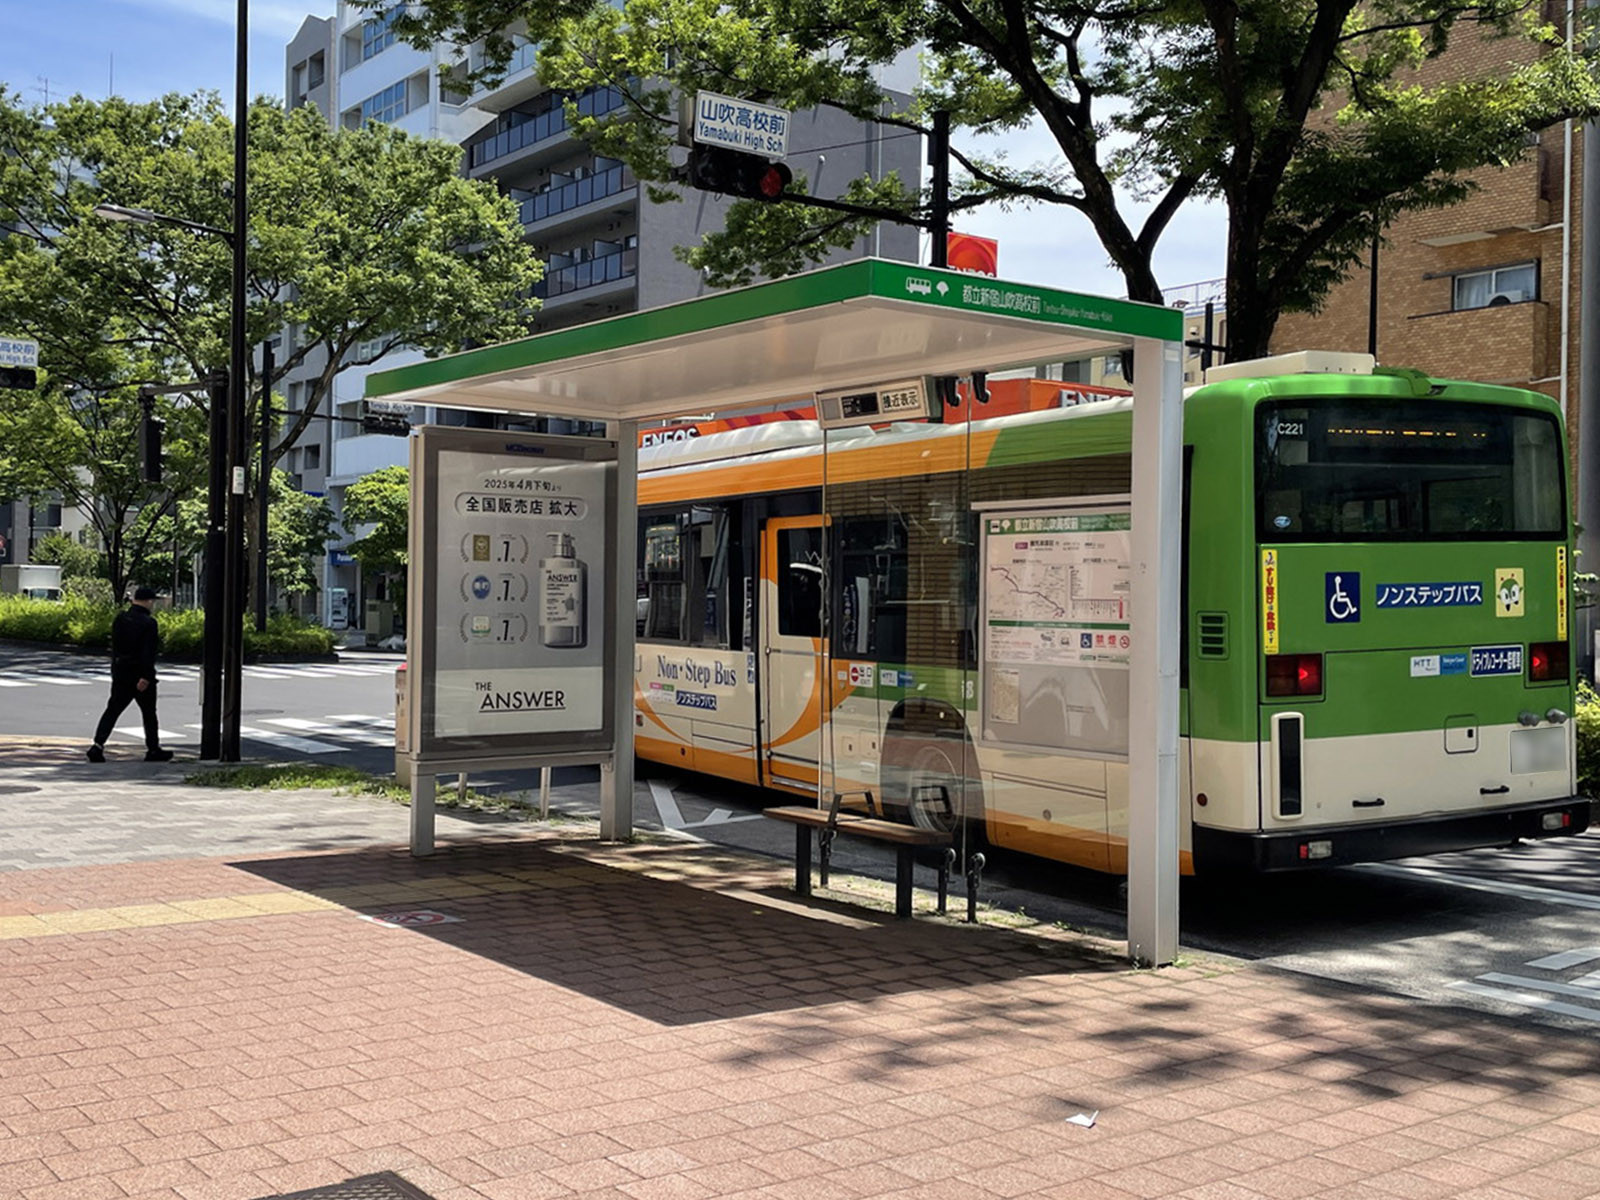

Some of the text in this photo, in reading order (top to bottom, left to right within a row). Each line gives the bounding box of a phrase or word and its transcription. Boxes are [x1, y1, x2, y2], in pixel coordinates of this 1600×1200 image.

[701, 100, 785, 136] 山吹高校前
[700, 121, 782, 152] Yamabuki High Sch
[1278, 423, 1303, 435] C221
[466, 496, 577, 516] 全国販売店 拡大
[1377, 585, 1482, 605] ノンステップバス
[1413, 658, 1431, 667] HTT
[714, 660, 737, 686] Bus
[475, 682, 492, 691] THE
[480, 690, 564, 710] ANSWER
